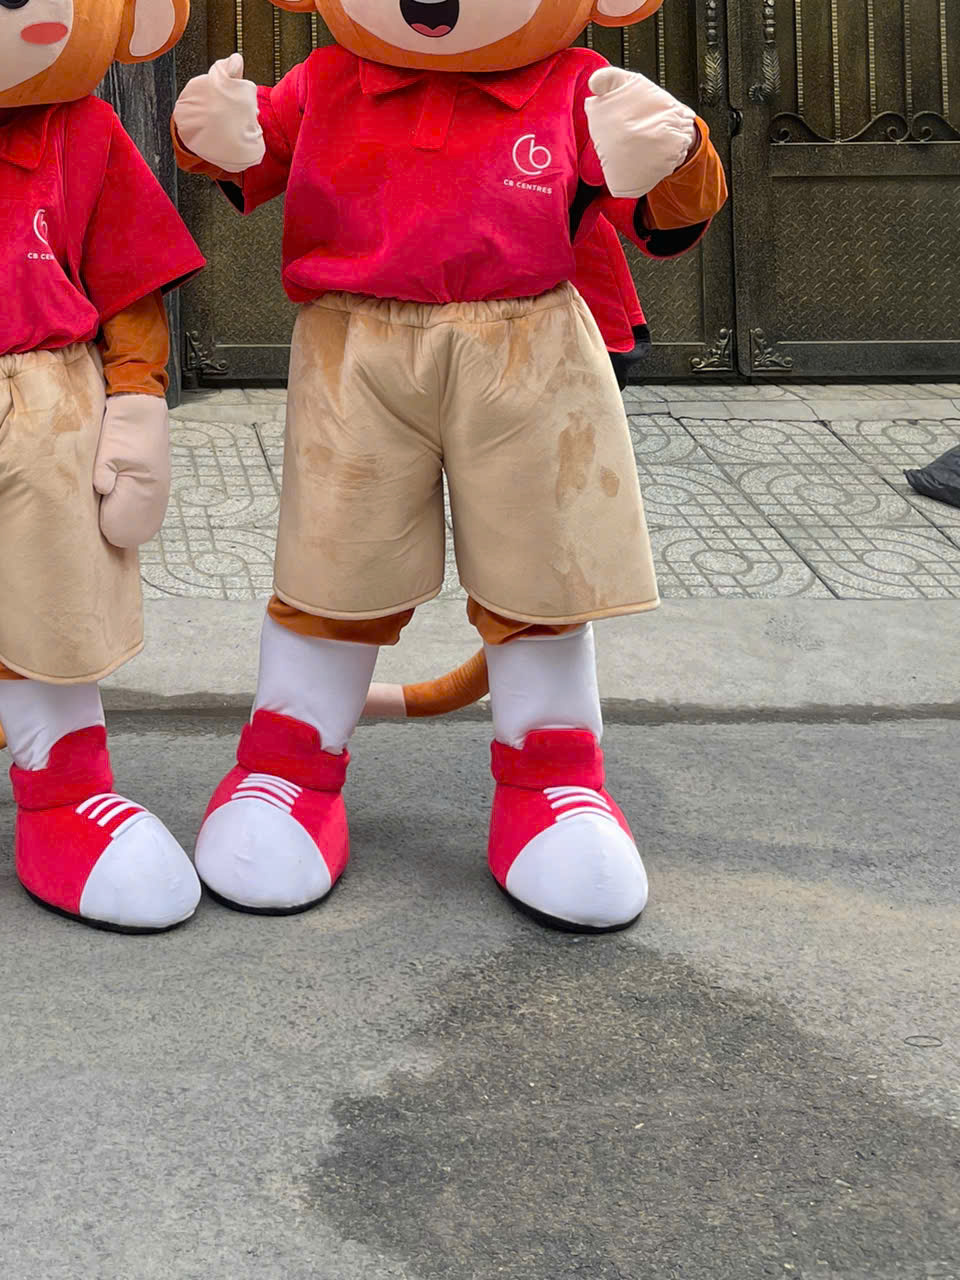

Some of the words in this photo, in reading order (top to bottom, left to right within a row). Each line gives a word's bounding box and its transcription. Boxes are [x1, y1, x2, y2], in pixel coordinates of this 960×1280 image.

[503, 179, 514, 187] CB
[515, 182, 552, 195] CENTRES
[27, 252, 39, 260] CB
